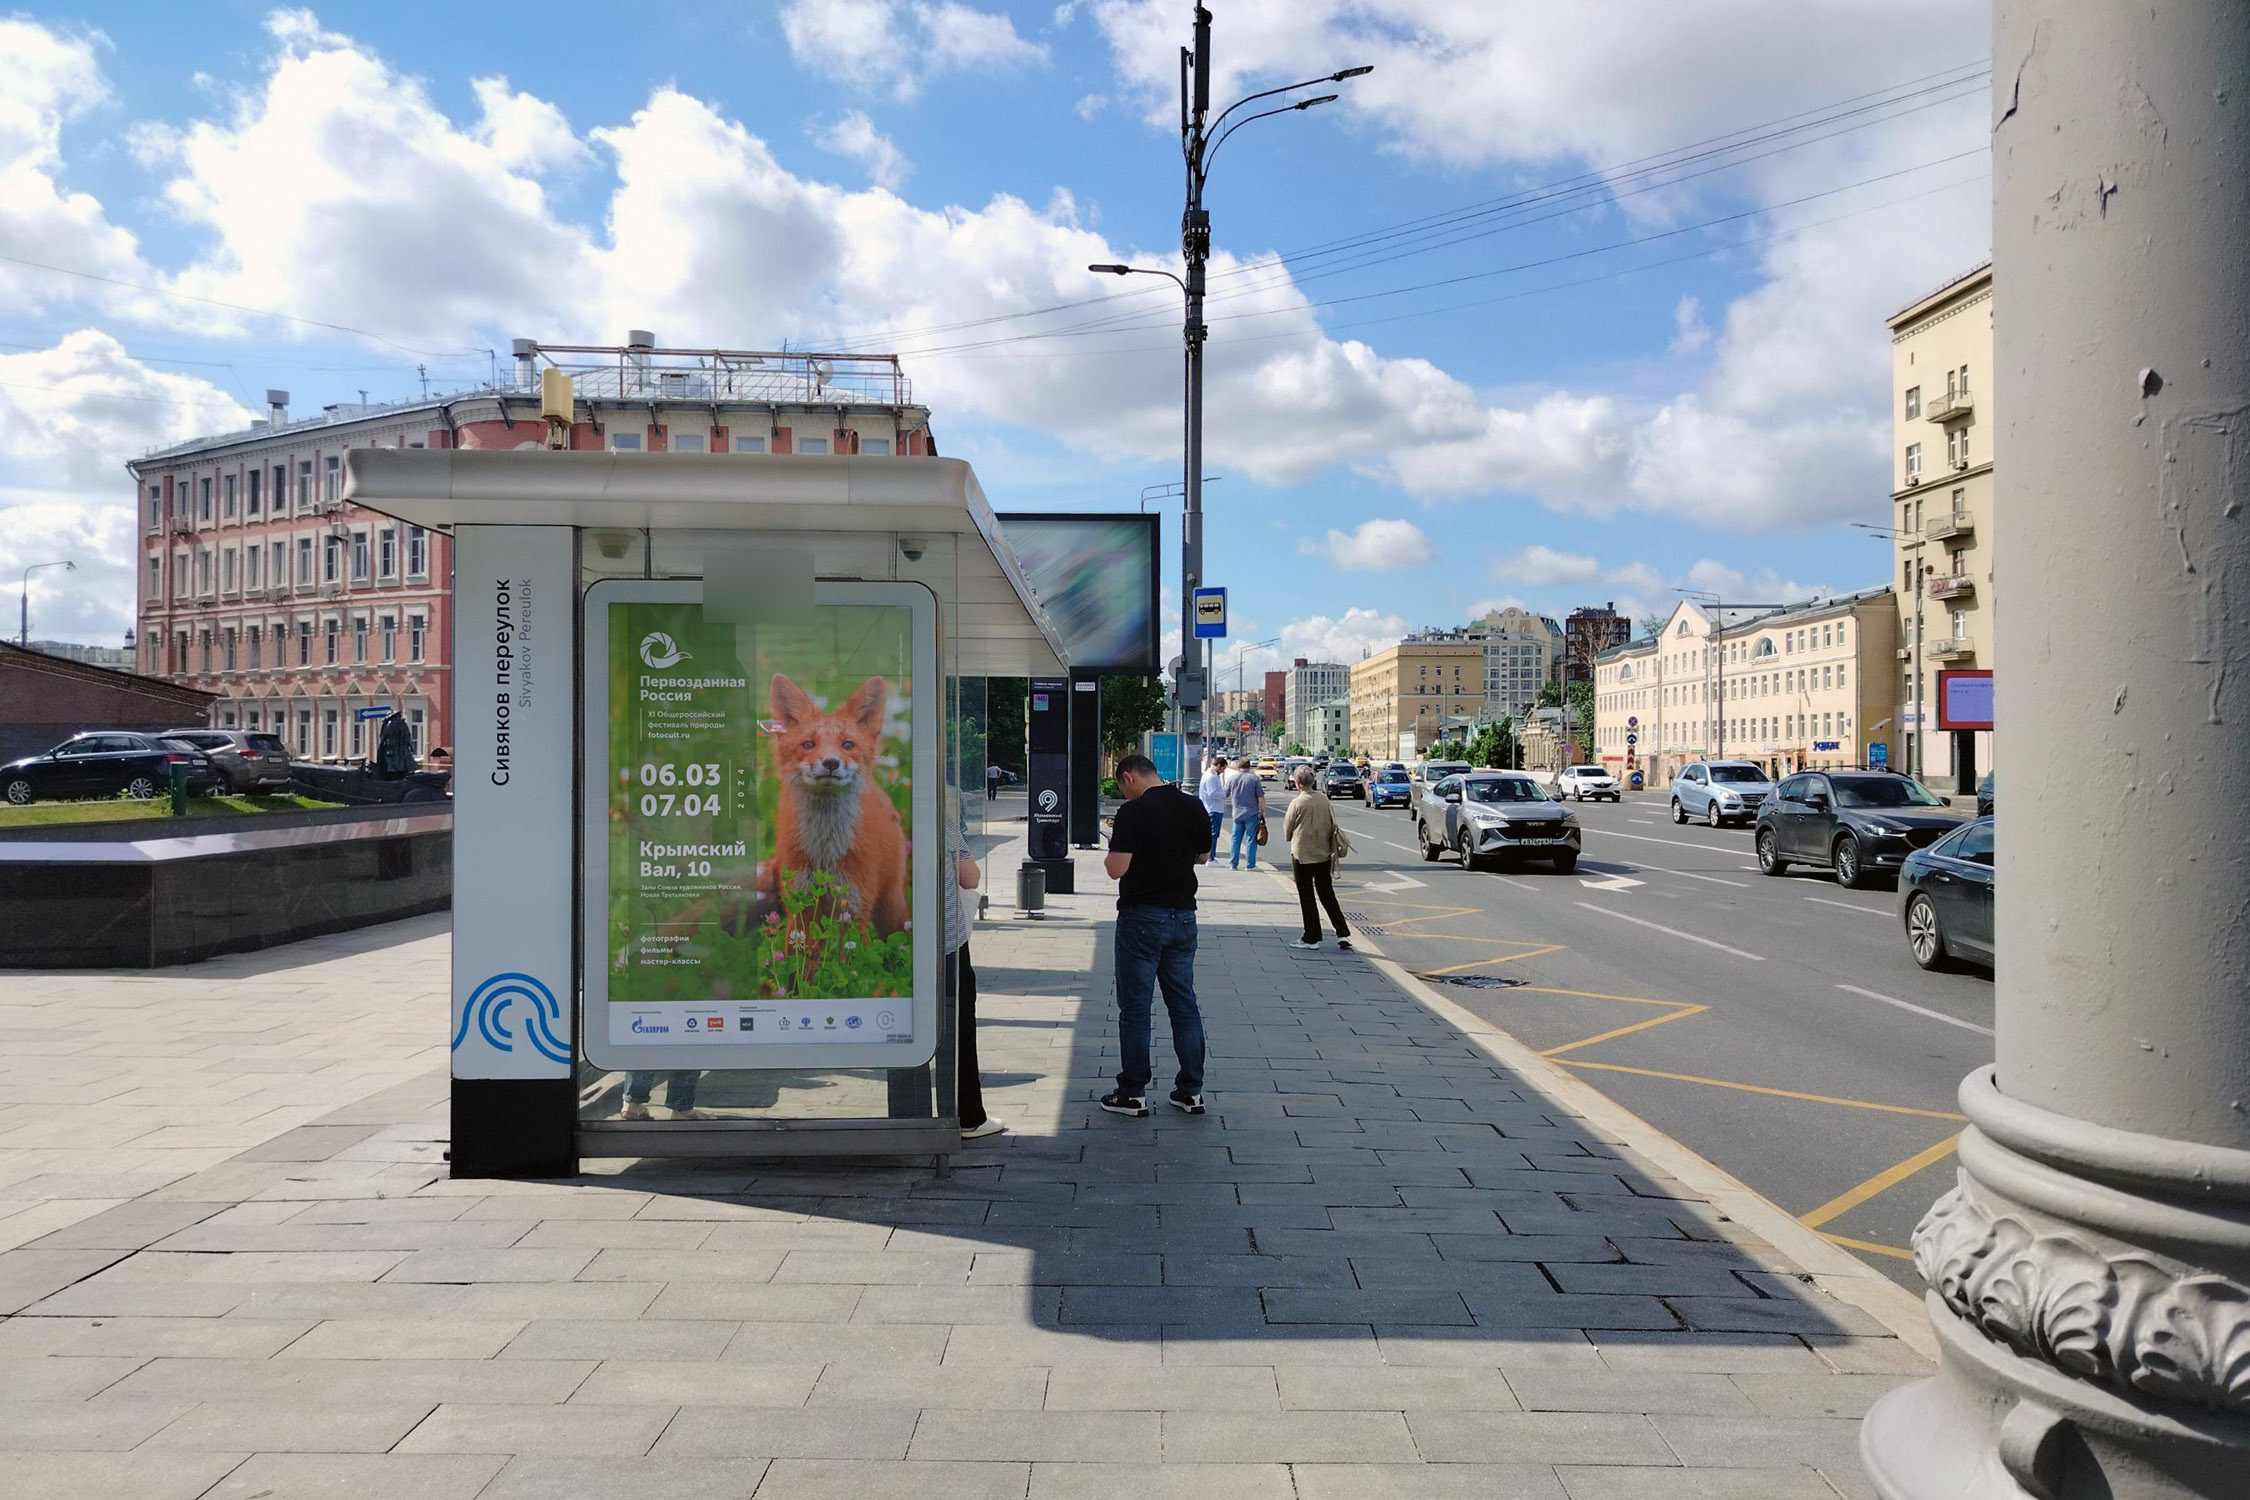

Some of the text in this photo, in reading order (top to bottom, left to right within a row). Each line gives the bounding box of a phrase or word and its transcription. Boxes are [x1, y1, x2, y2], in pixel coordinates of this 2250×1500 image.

[518, 578, 534, 708] Sivyakov Pereulok
[491, 579, 514, 786] Сивяков переулок
[640, 675, 746, 690] Первозданная
[640, 689, 692, 701] Россия
[657, 710, 726, 719] Общероссийский
[690, 722, 725, 730] природы
[648, 731, 690, 739] fotocult.ru
[640, 763, 721, 787] 06.03
[737, 768, 745, 809] 2024
[640, 794, 721, 817] 07.04
[640, 840, 746, 861] Крымский
[640, 861, 712, 879] Вал, 10
[679, 884, 717, 892] художников
[640, 935, 690, 943] фотографии
[640, 957, 701, 966] мастер-классы
